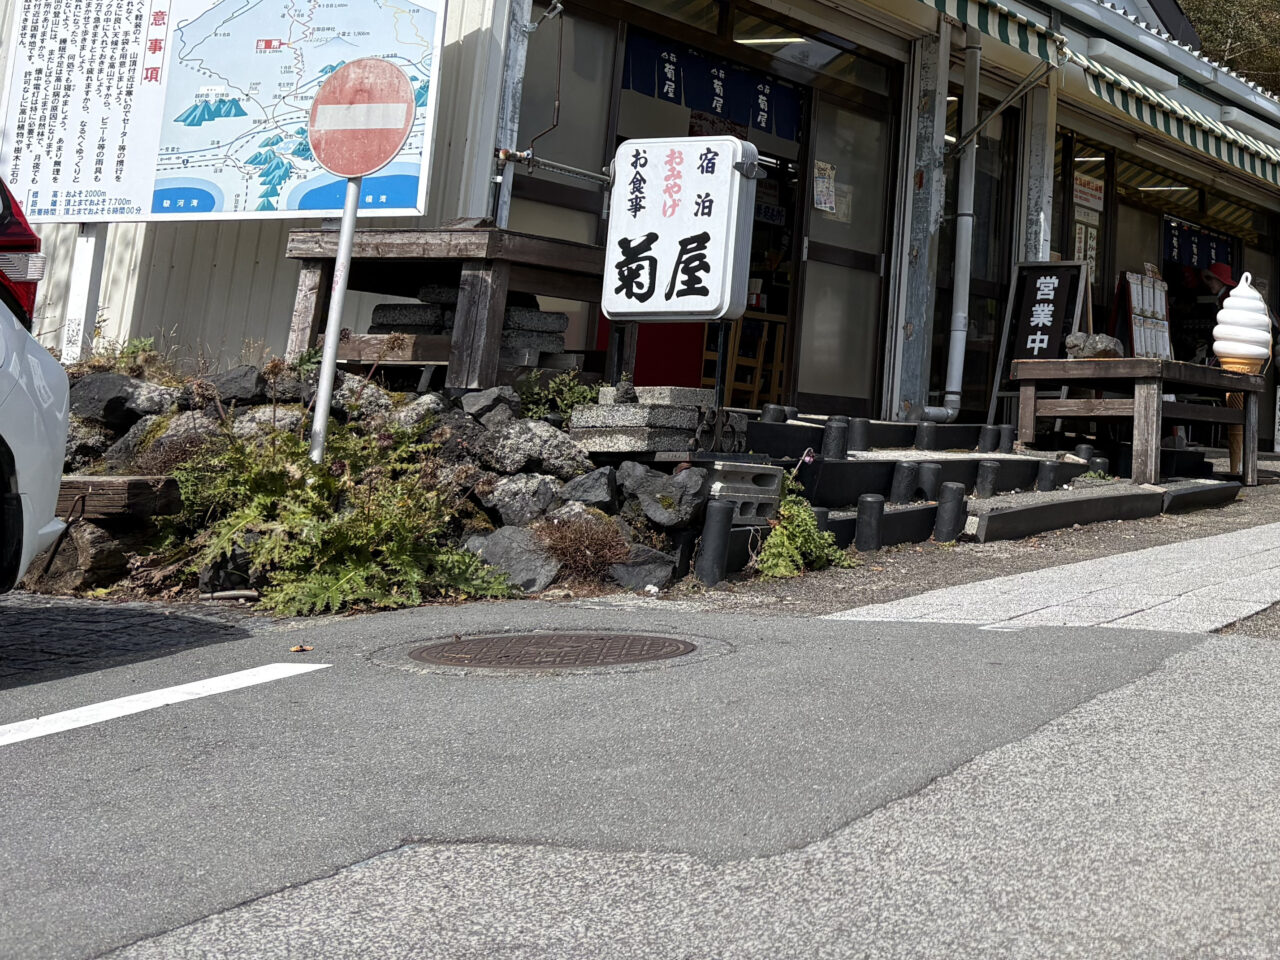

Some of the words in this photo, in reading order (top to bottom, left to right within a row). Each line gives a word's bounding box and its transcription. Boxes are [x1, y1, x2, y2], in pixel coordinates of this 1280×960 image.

[627, 149, 648, 219] お食事
[662, 149, 683, 218] おみやげ
[693, 147, 719, 217] 宿泊
[614, 231, 711, 302] 菊屋
[1026, 276, 1059, 356] 営業中
